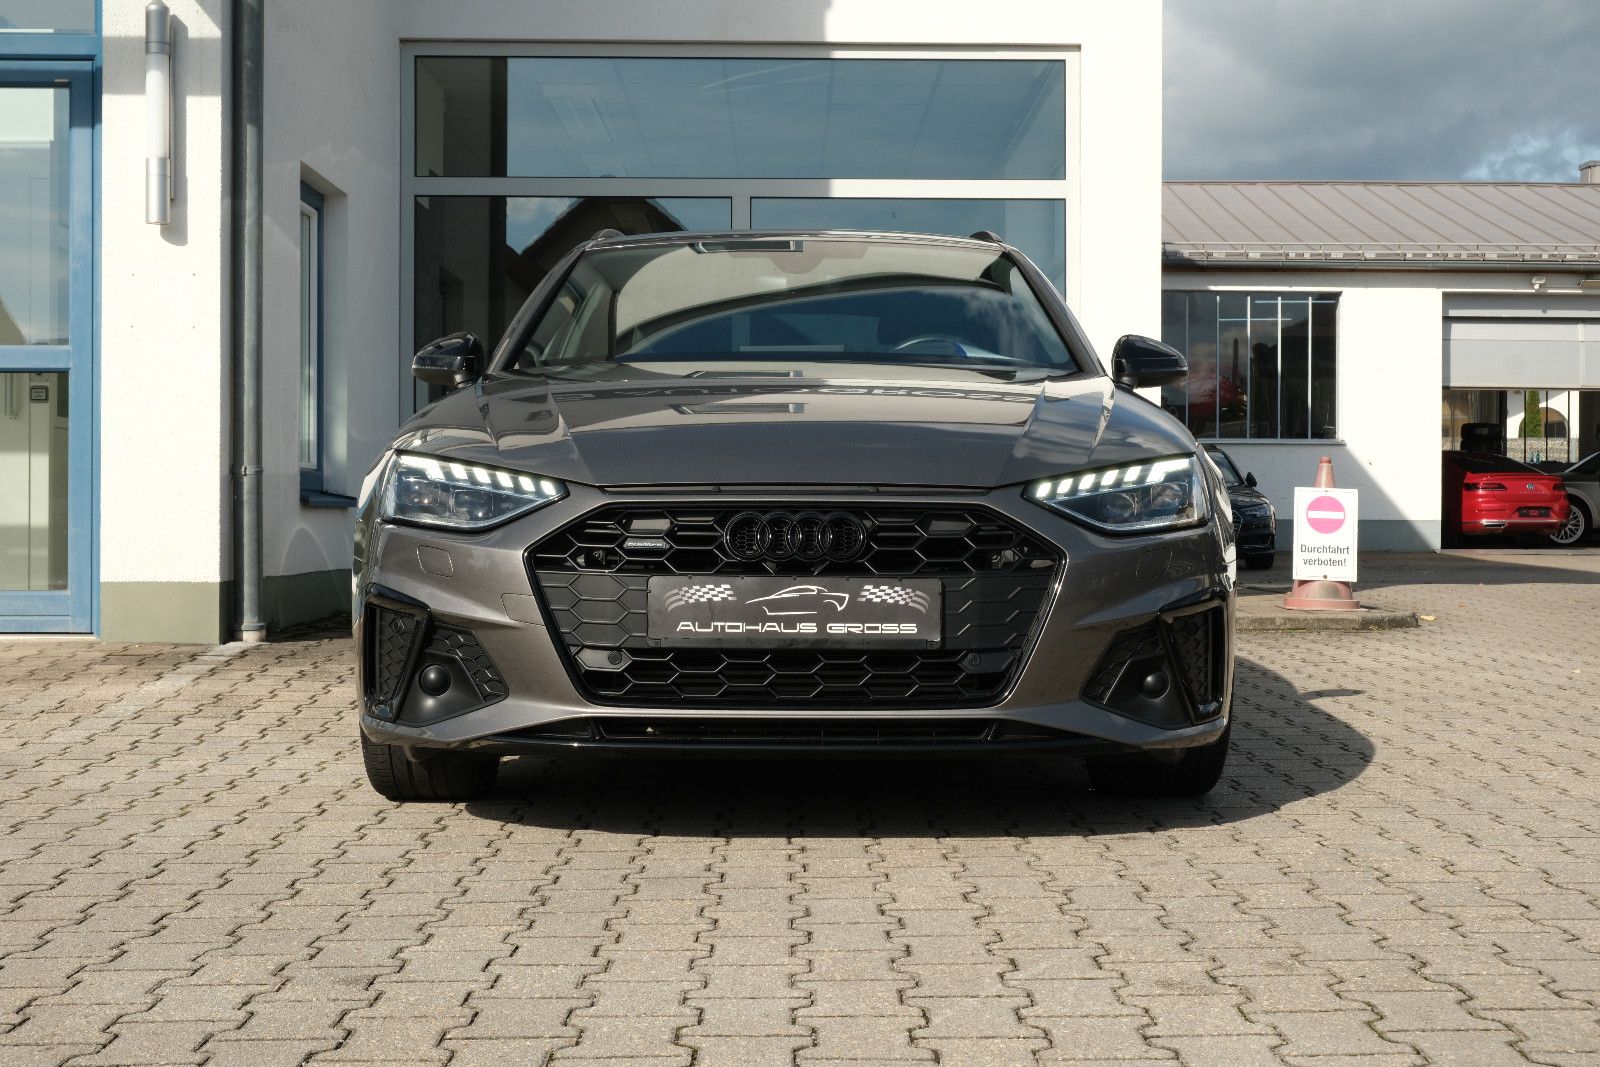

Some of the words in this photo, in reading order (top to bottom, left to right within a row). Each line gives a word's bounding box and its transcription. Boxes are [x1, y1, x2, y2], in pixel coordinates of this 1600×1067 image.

[1300, 544, 1350, 555] Durchfahrt
[1303, 557, 1347, 567] verboten!
[676, 621, 818, 633] AUTOHAUS
[826, 623, 918, 634] GROSS
